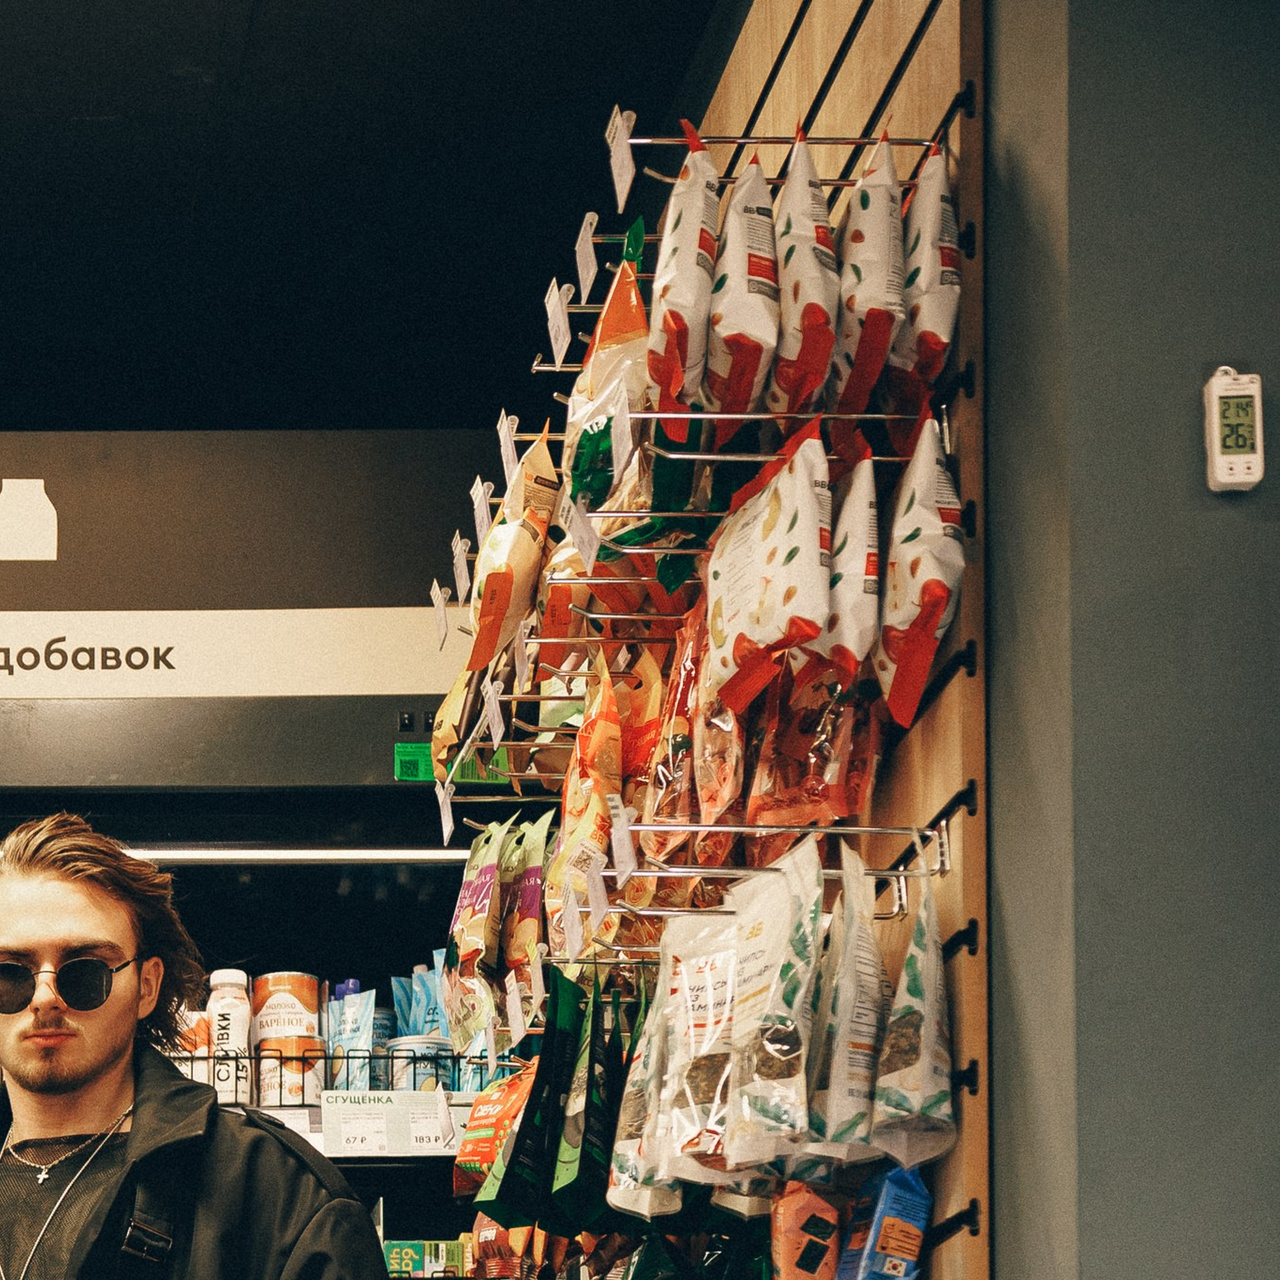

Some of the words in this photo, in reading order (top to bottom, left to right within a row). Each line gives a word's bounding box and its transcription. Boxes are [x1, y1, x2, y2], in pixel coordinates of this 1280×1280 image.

[1222, 423, 1248, 449] 26
[326, 1094, 394, 1106] СГУЩЁНКА
[345, 1136, 357, 1144] 67
